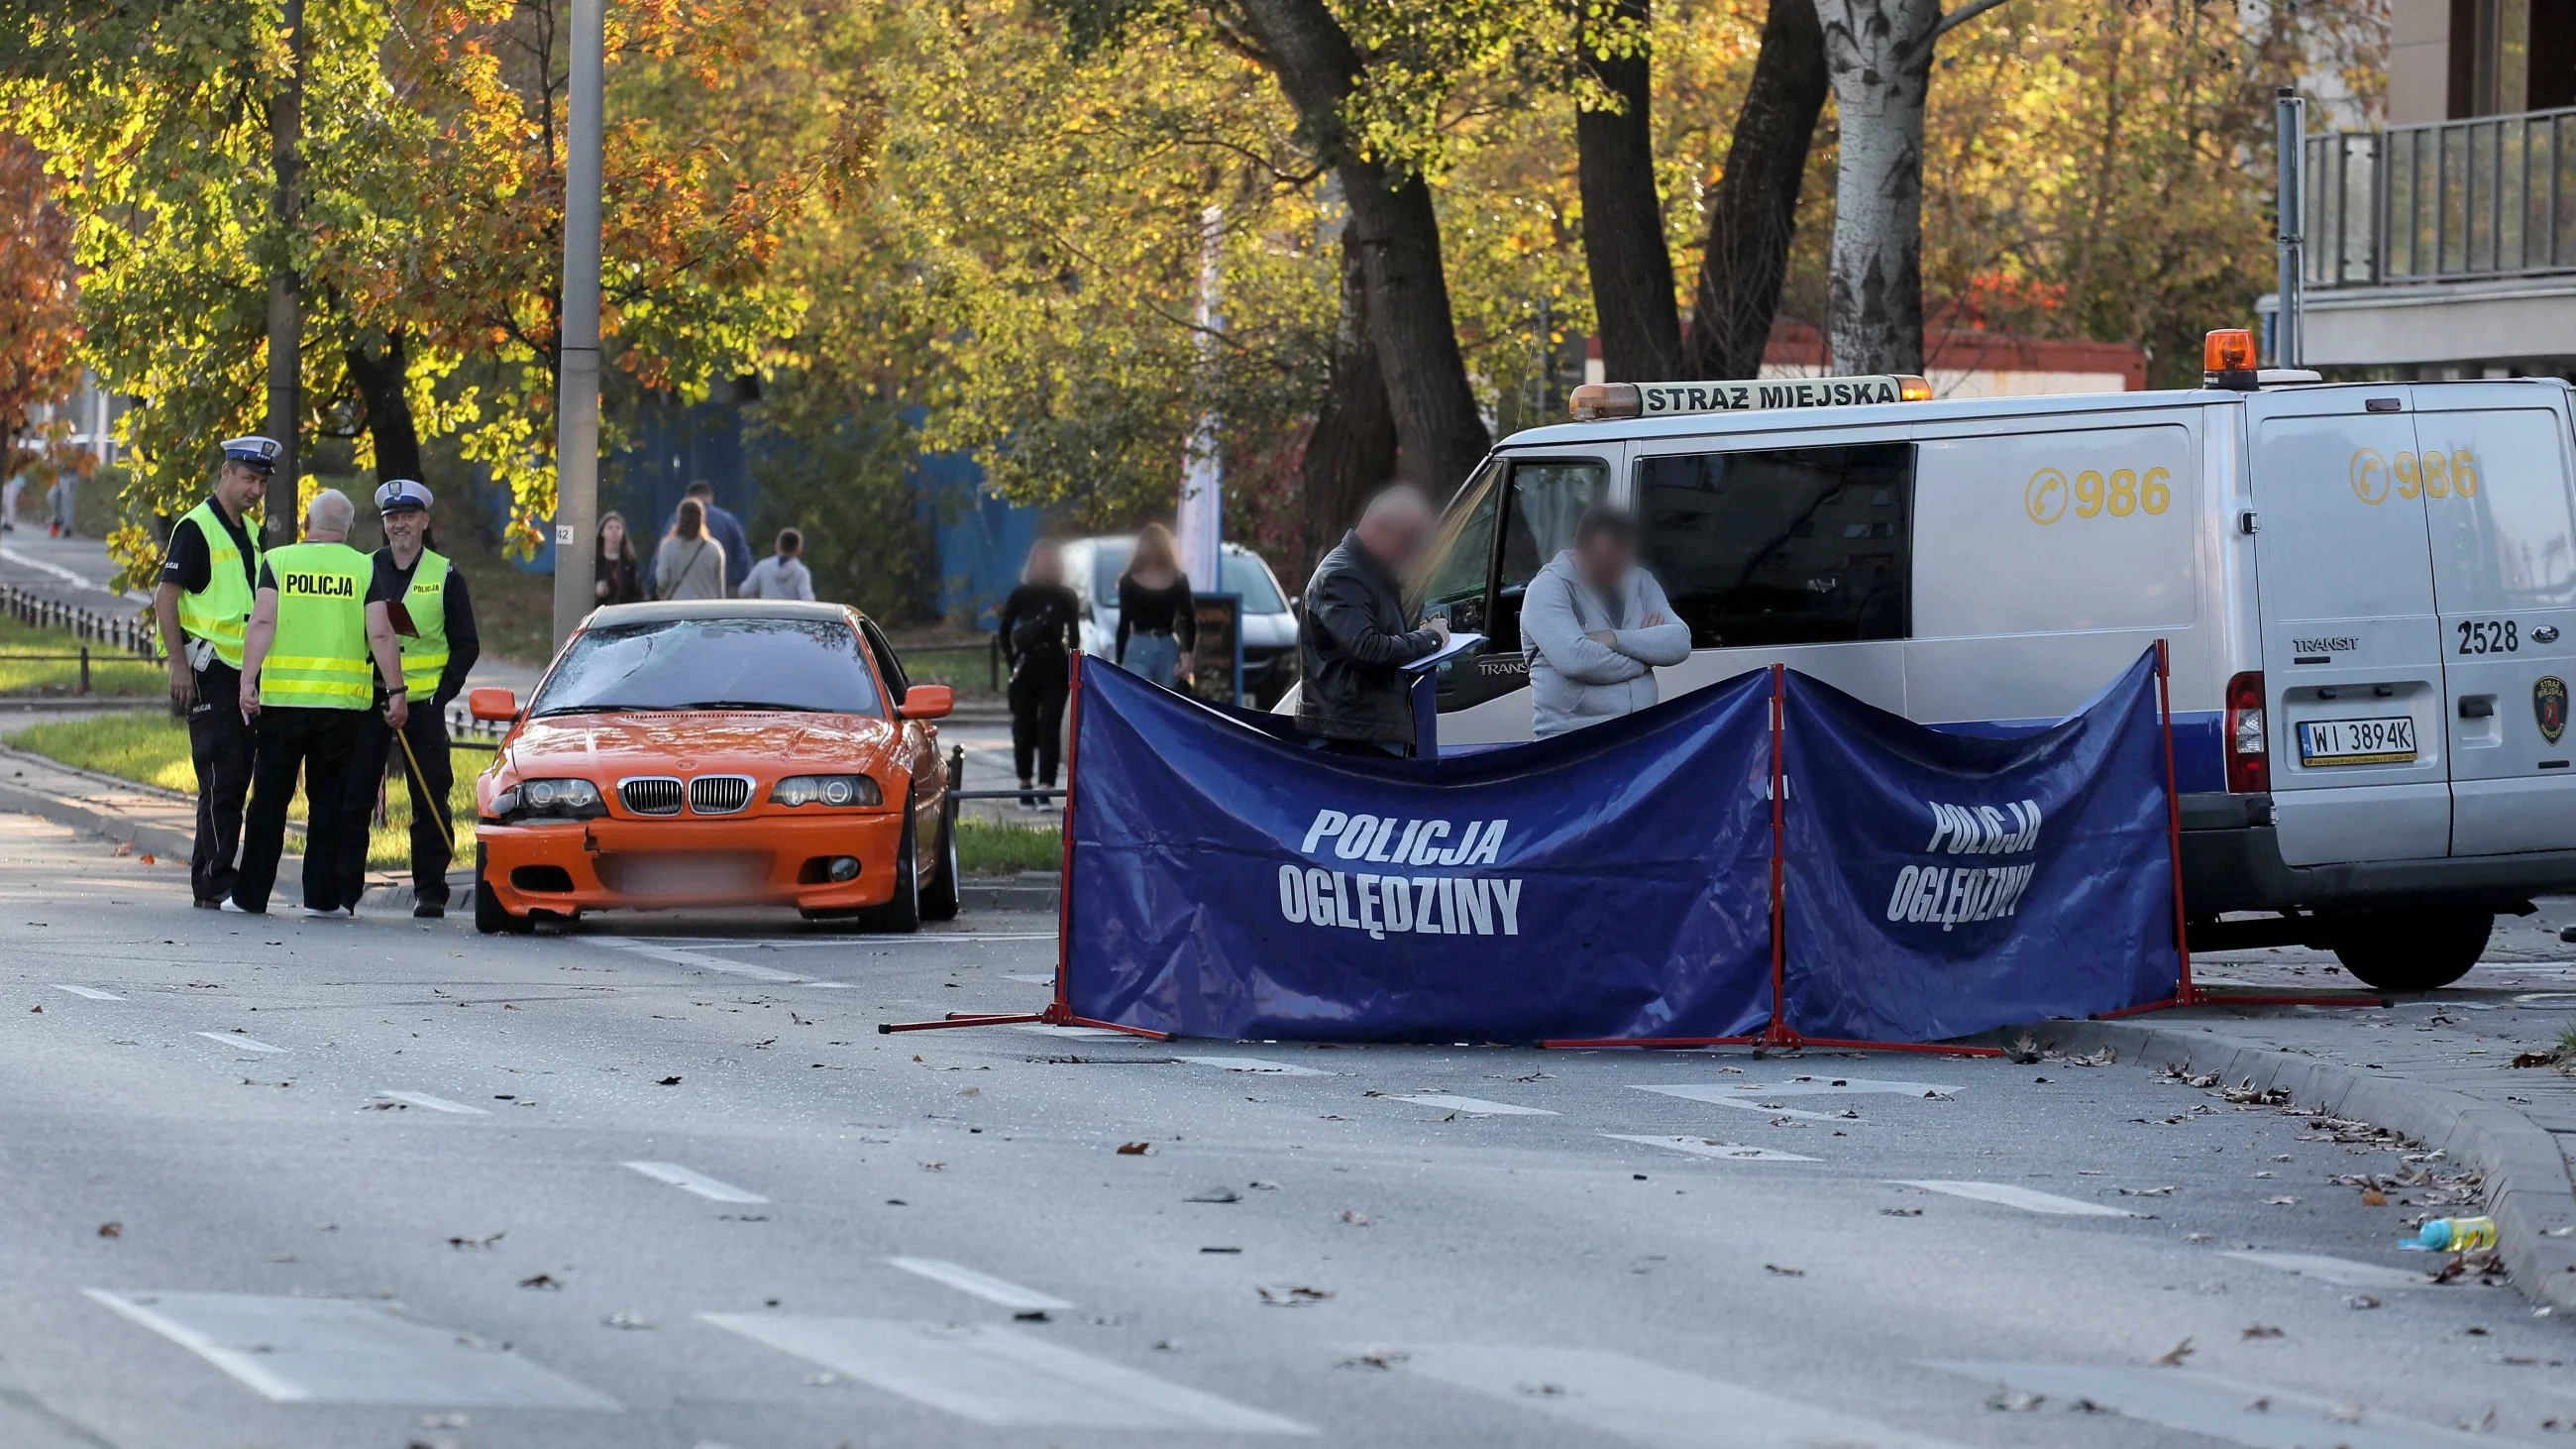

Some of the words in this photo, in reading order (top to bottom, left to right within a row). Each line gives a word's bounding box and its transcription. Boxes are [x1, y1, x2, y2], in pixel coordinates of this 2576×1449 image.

[1760, 383, 1896, 408] MIEJSKA
[2074, 467, 2171, 518] 986
[2394, 450, 2478, 499] 986
[286, 574, 353, 597] POLICJA
[413, 584, 440, 594] POLICJA
[2293, 636, 2359, 652] TRANSIT
[2457, 619, 2520, 655] 2528
[1479, 662, 1529, 675] TRANS
[2349, 722, 2412, 751] 3894K
[1301, 809, 1509, 866] POLICJA
[1925, 800, 2042, 854] POLICJA
[1278, 864, 1523, 941] OGLĘDZINY
[1886, 862, 2036, 932] OGLĘDZINY
